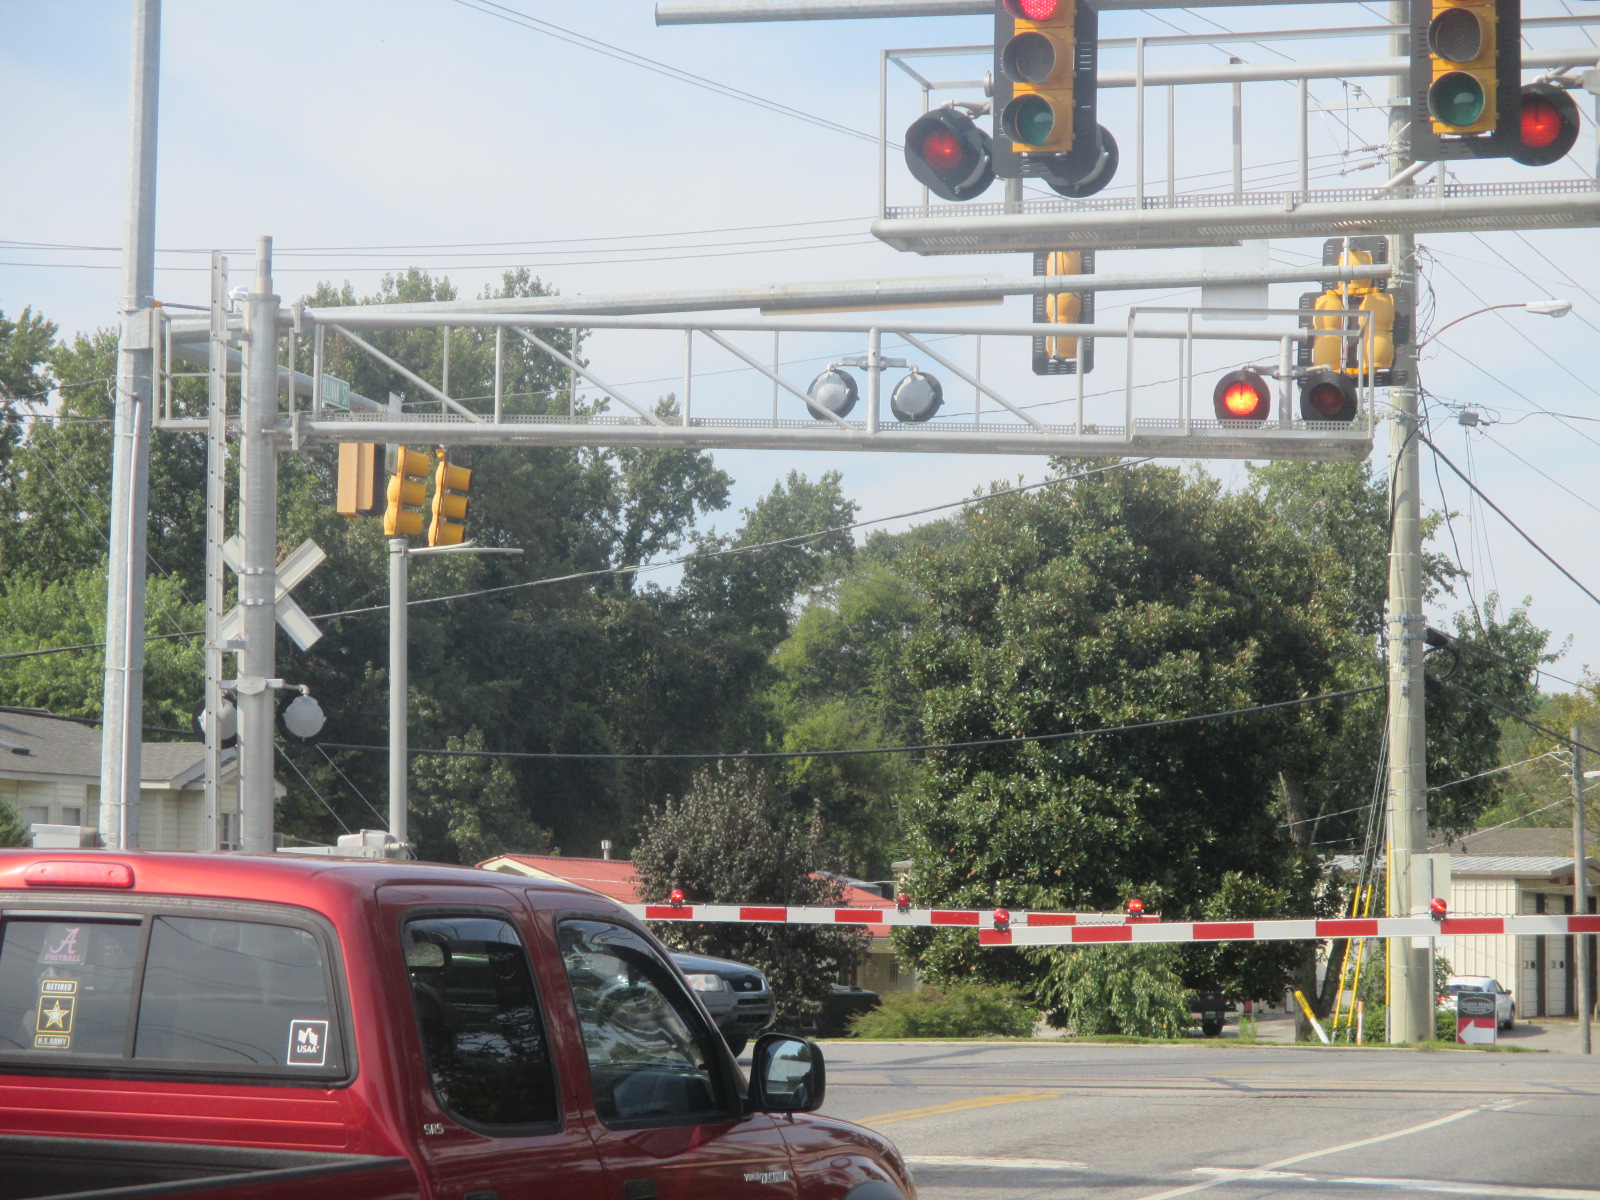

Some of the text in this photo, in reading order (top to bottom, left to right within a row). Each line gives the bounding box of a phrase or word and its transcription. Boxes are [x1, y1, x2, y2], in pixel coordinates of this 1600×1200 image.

[44, 953, 81, 962] FOOTBALL
[45, 982, 73, 992] RETIRED
[296, 1045, 317, 1053] USAA
